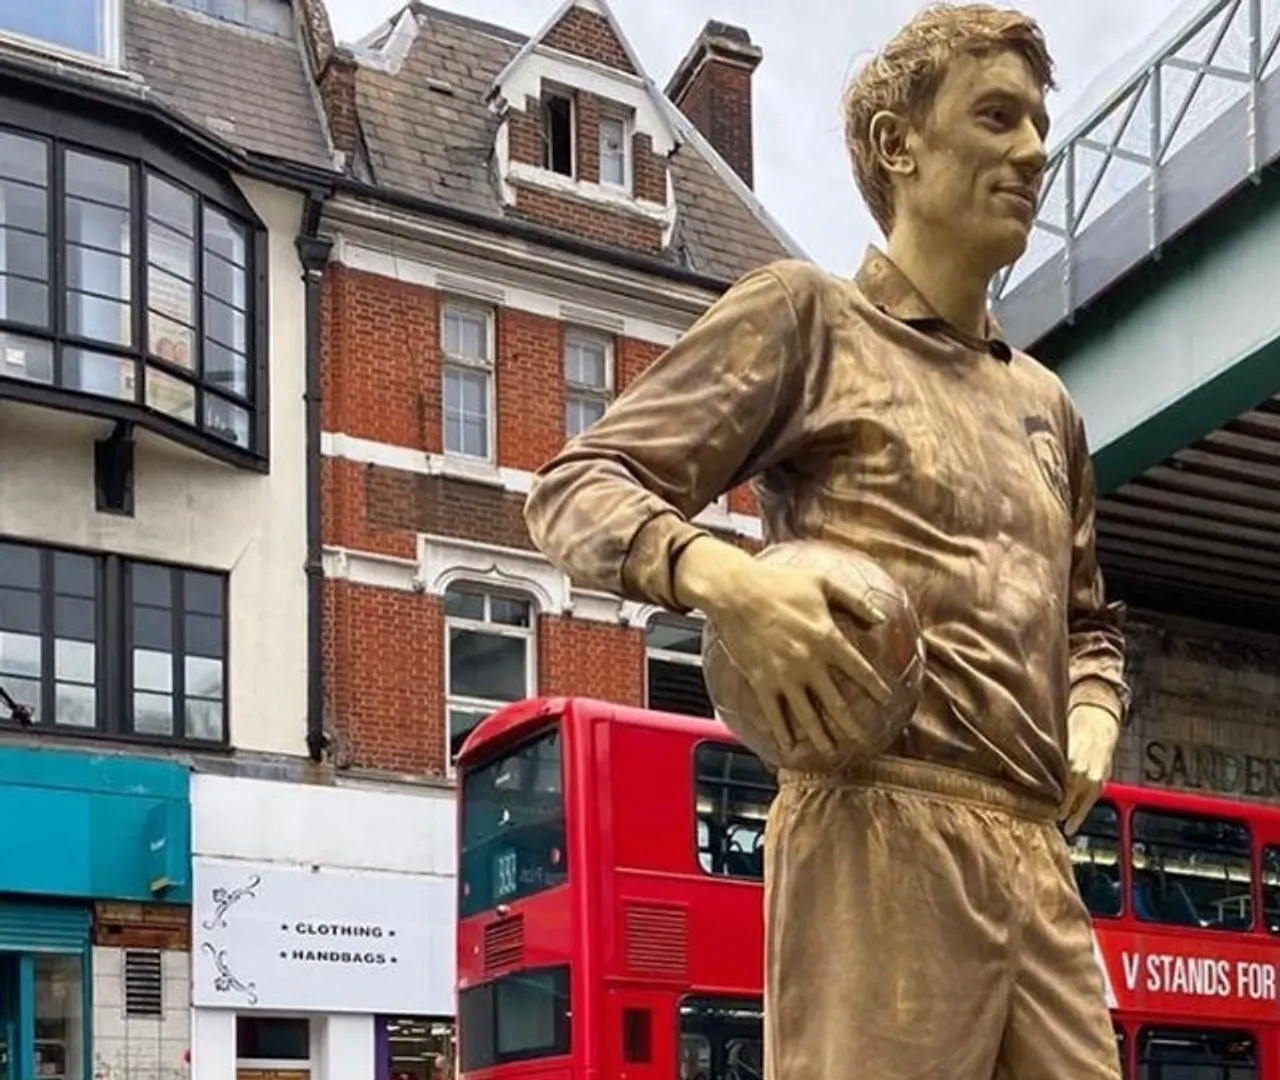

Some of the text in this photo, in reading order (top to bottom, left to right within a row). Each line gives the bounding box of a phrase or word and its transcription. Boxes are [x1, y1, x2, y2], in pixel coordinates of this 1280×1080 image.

[295, 922, 383, 938] CLOTHING
[292, 950, 386, 964] HANDBAGS
[1122, 952, 1140, 991] V
[1147, 954, 1231, 997] STANDS
[1237, 961, 1276, 1000] FOR
